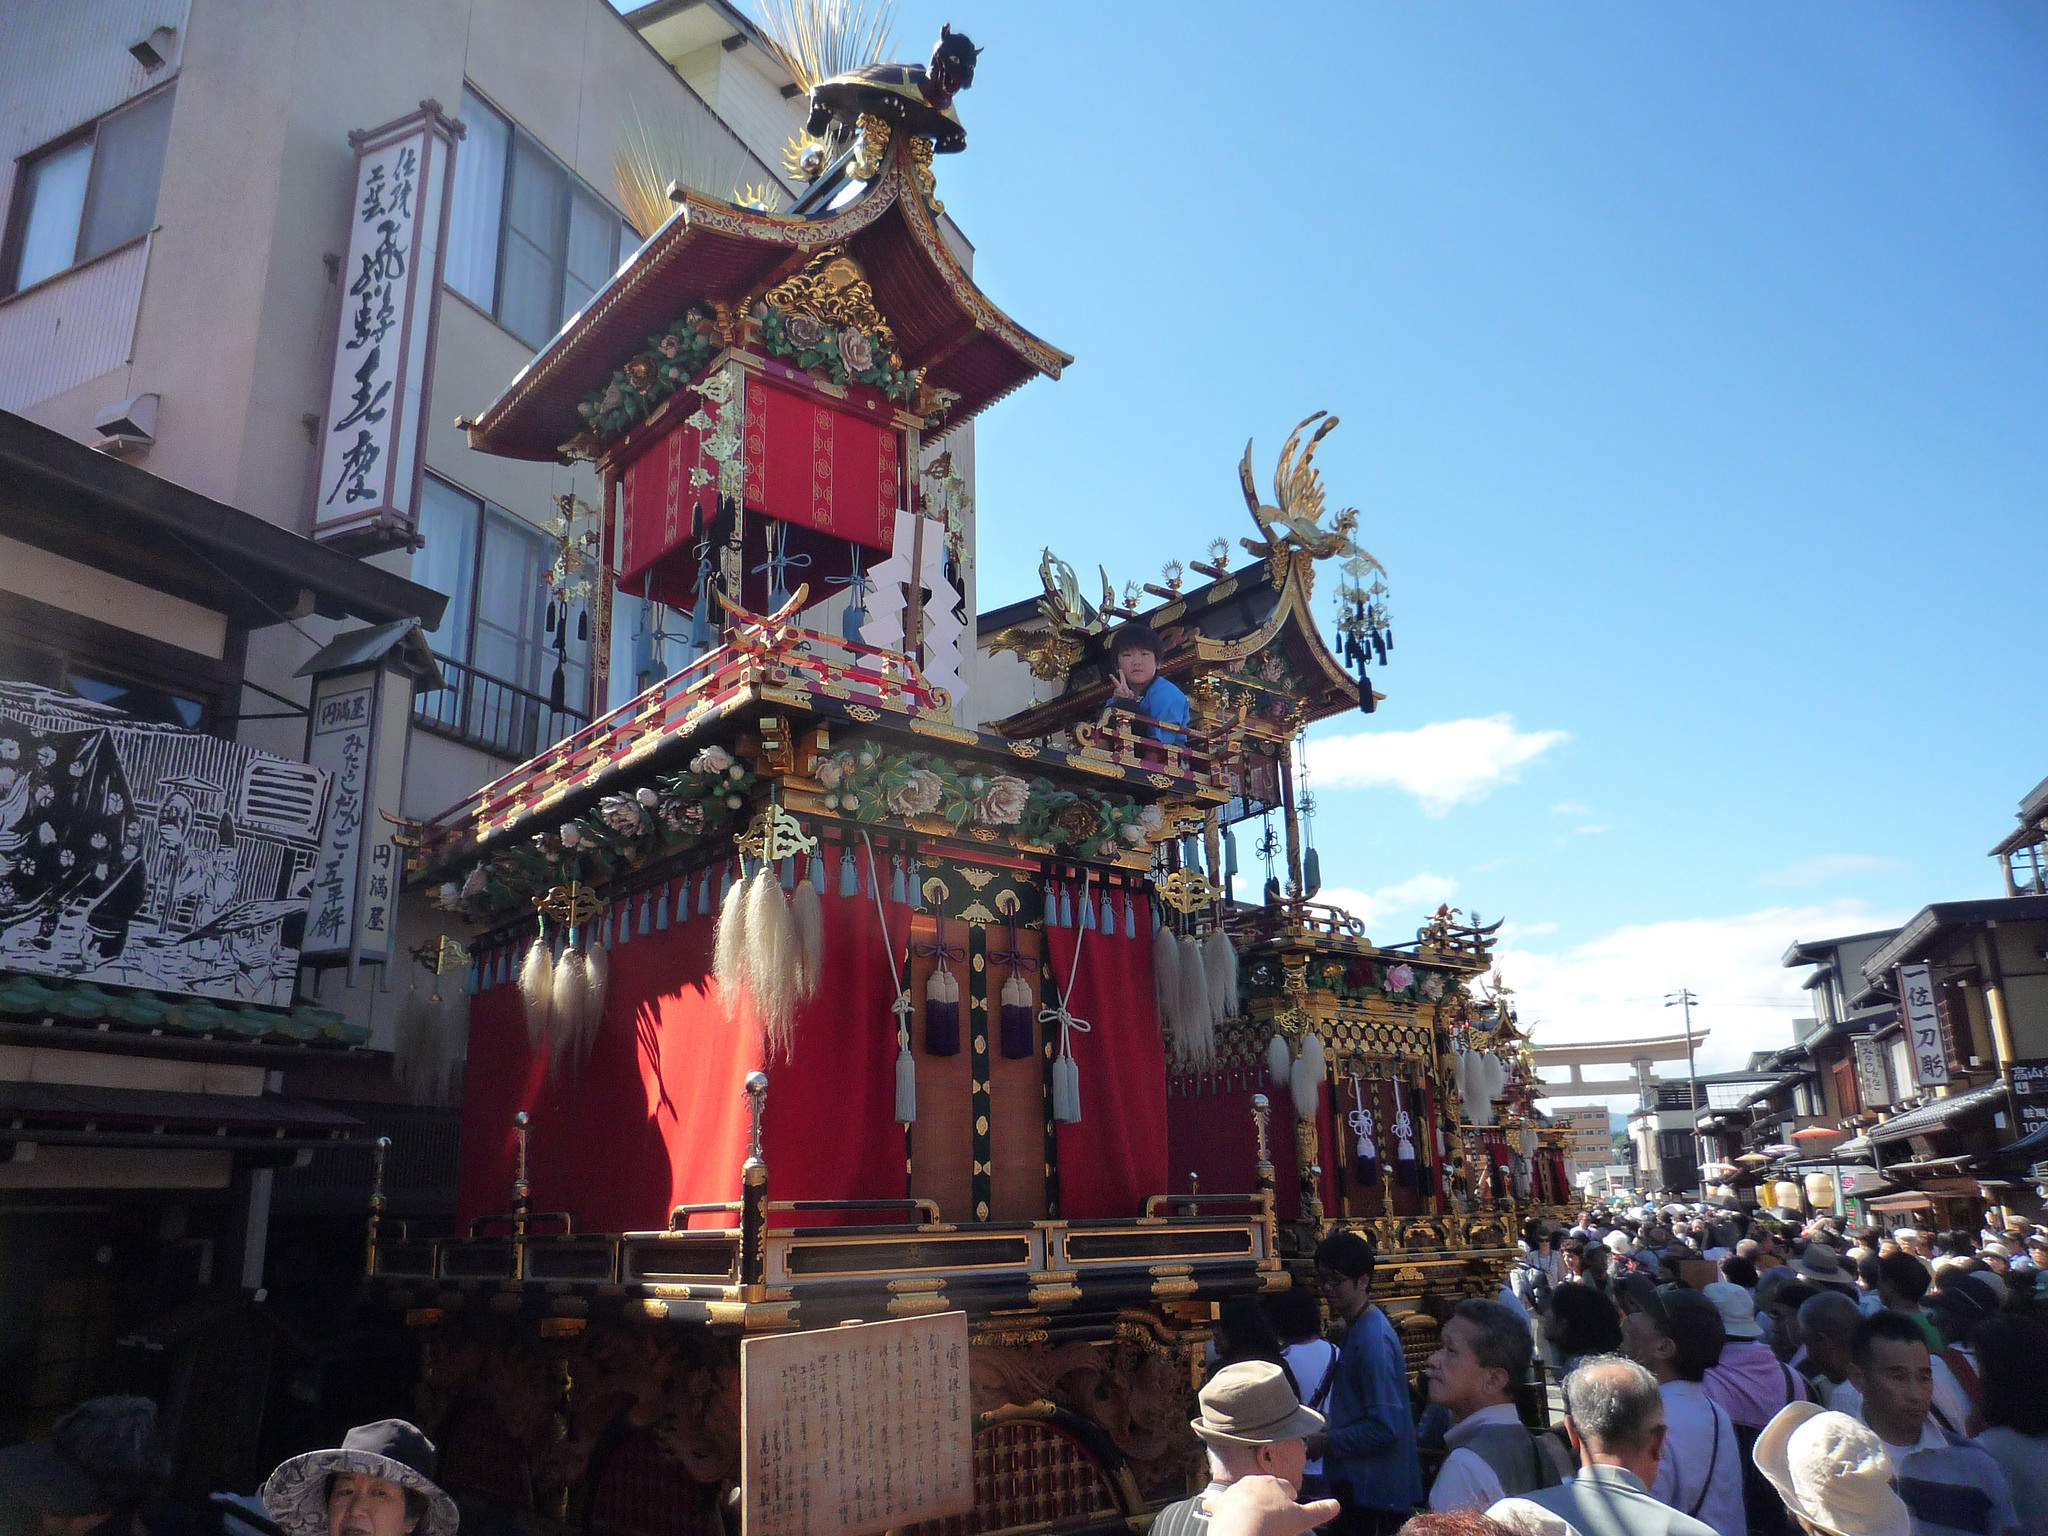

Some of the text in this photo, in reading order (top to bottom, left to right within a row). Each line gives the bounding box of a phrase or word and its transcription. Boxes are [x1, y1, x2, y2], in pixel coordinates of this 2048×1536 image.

[321, 695, 365, 725] 円満屋
[365, 844, 391, 932] 円満屋
[1903, 969, 1945, 1078] 一位一刀彫
